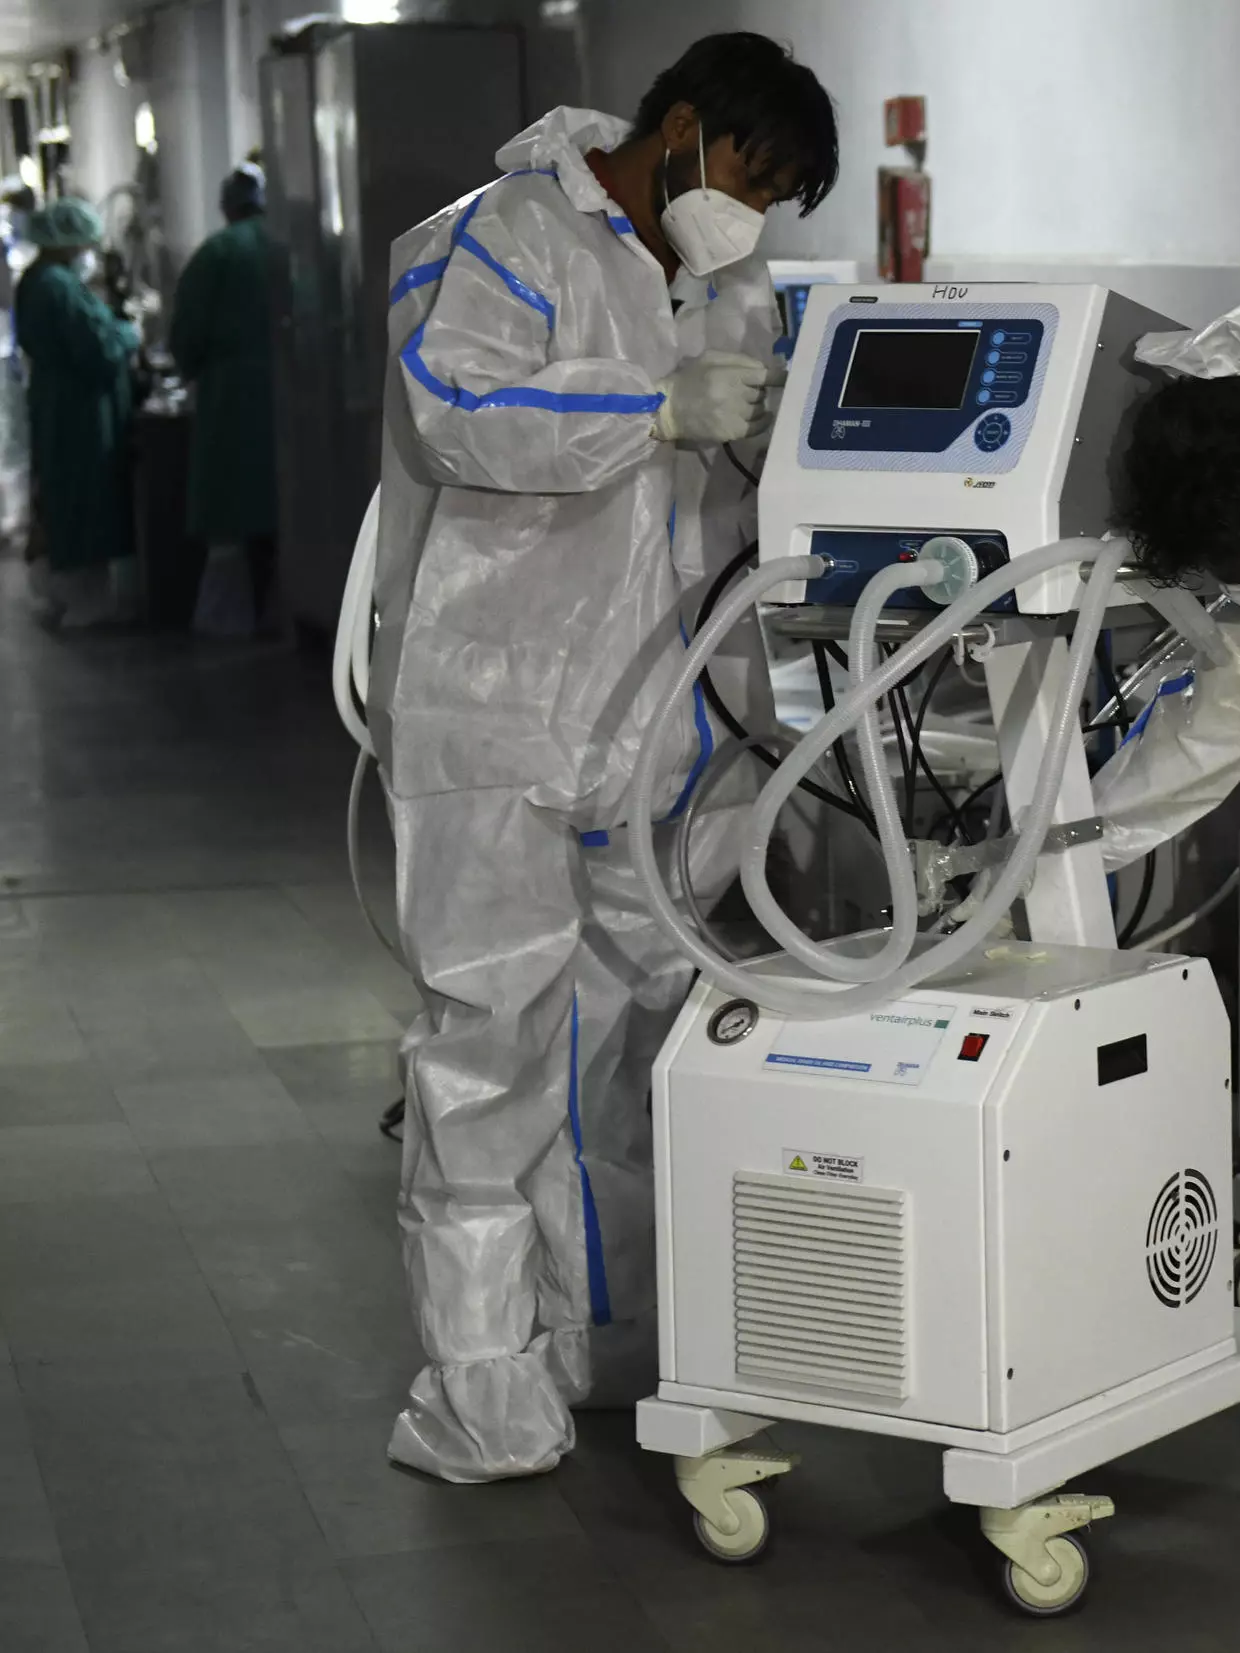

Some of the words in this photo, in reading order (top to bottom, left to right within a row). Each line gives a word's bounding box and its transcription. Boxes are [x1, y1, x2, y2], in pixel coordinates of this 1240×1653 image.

[870, 1013, 933, 1028] ventairplus
[823, 1157, 836, 1165] NOT
[837, 1159, 858, 1167] BLOCK
